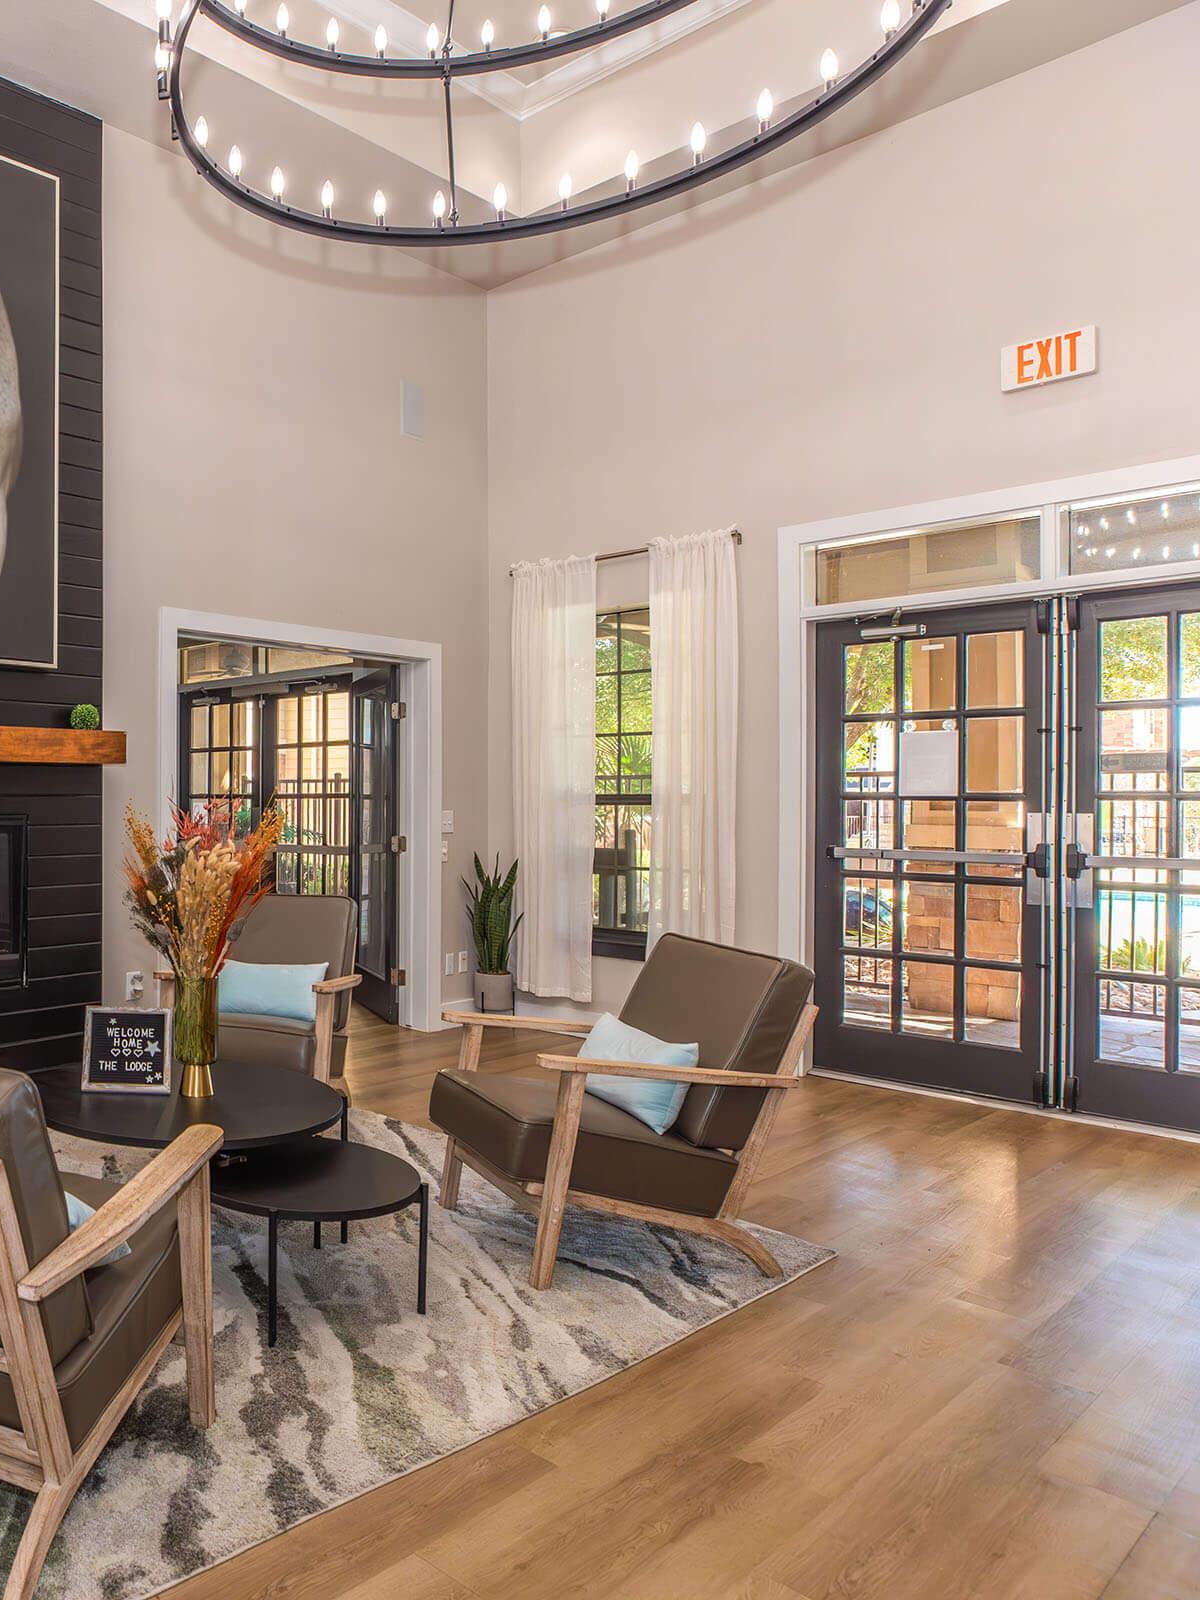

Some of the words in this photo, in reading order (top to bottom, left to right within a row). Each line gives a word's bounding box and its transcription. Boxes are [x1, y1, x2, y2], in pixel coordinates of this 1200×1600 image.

[1017, 330, 1082, 385] EXIT
[106, 1027, 156, 1038] WELCOME
[113, 1037, 143, 1049] HOME
[98, 1060, 118, 1071] THE
[125, 1061, 153, 1072] LODGE
